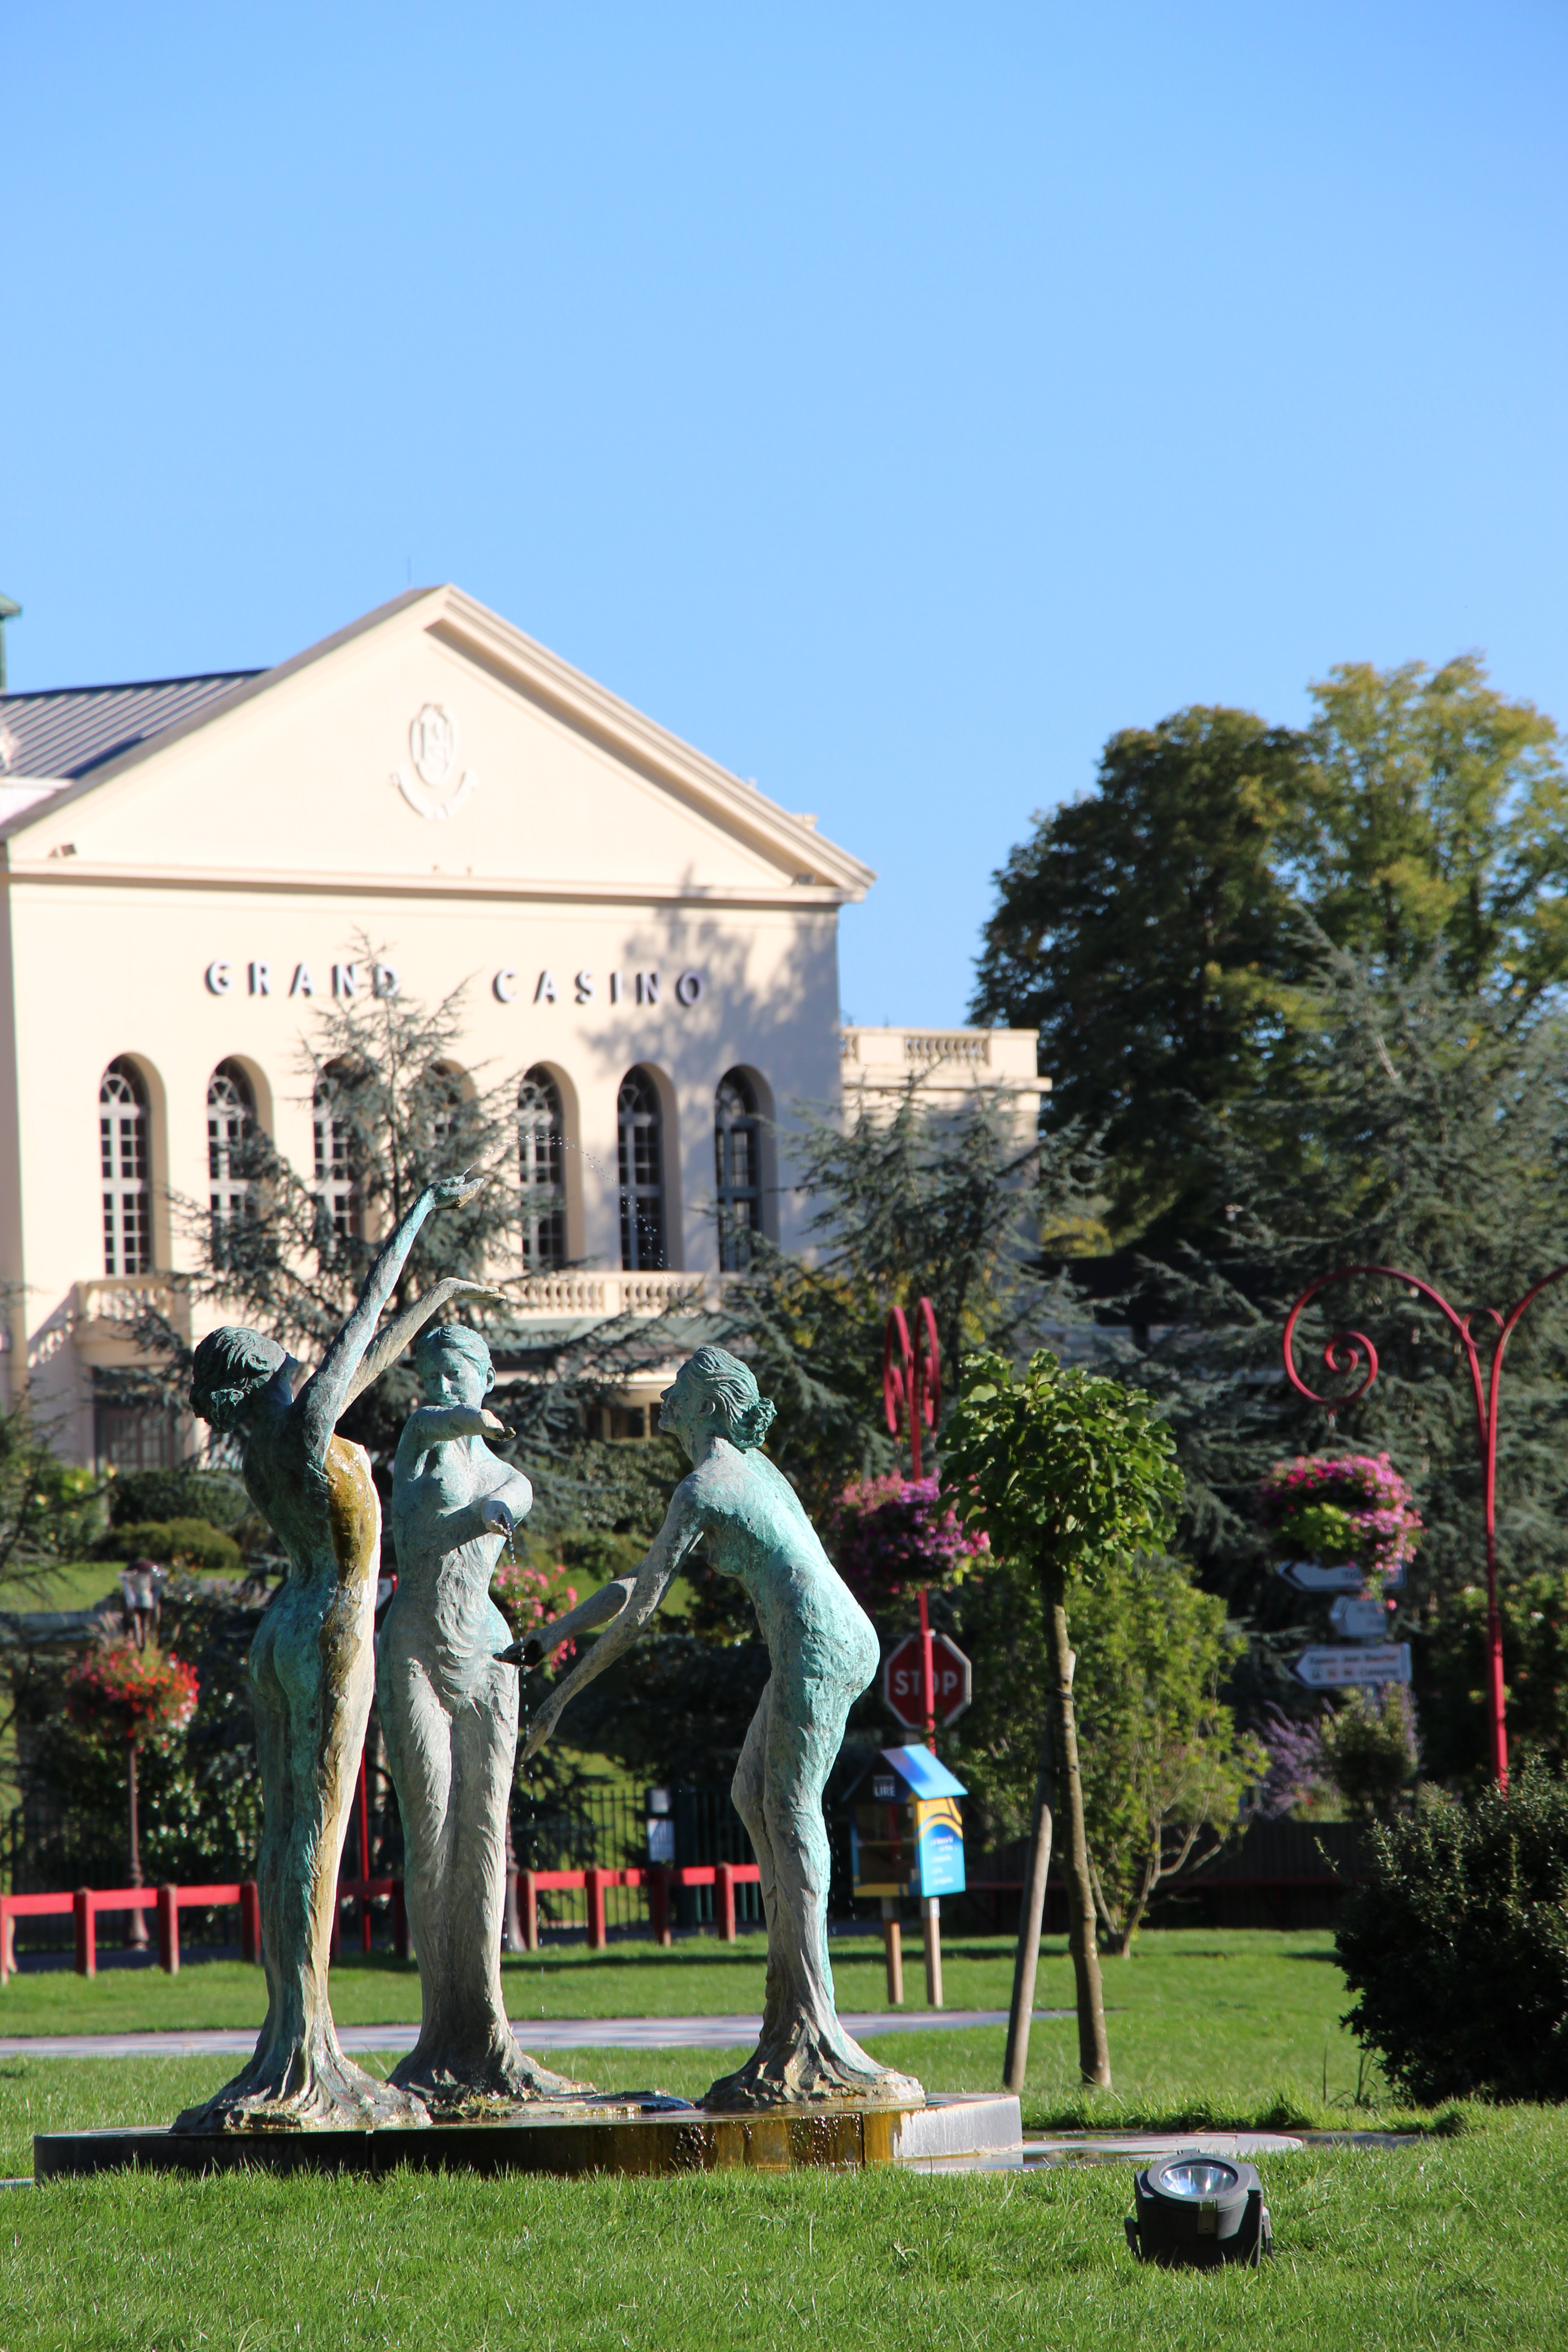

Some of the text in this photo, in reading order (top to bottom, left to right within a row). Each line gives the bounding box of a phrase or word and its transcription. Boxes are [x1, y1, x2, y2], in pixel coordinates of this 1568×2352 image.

[205, 960, 703, 1007] GRAND CASINO
[874, 1786, 896, 1797] LIRE
